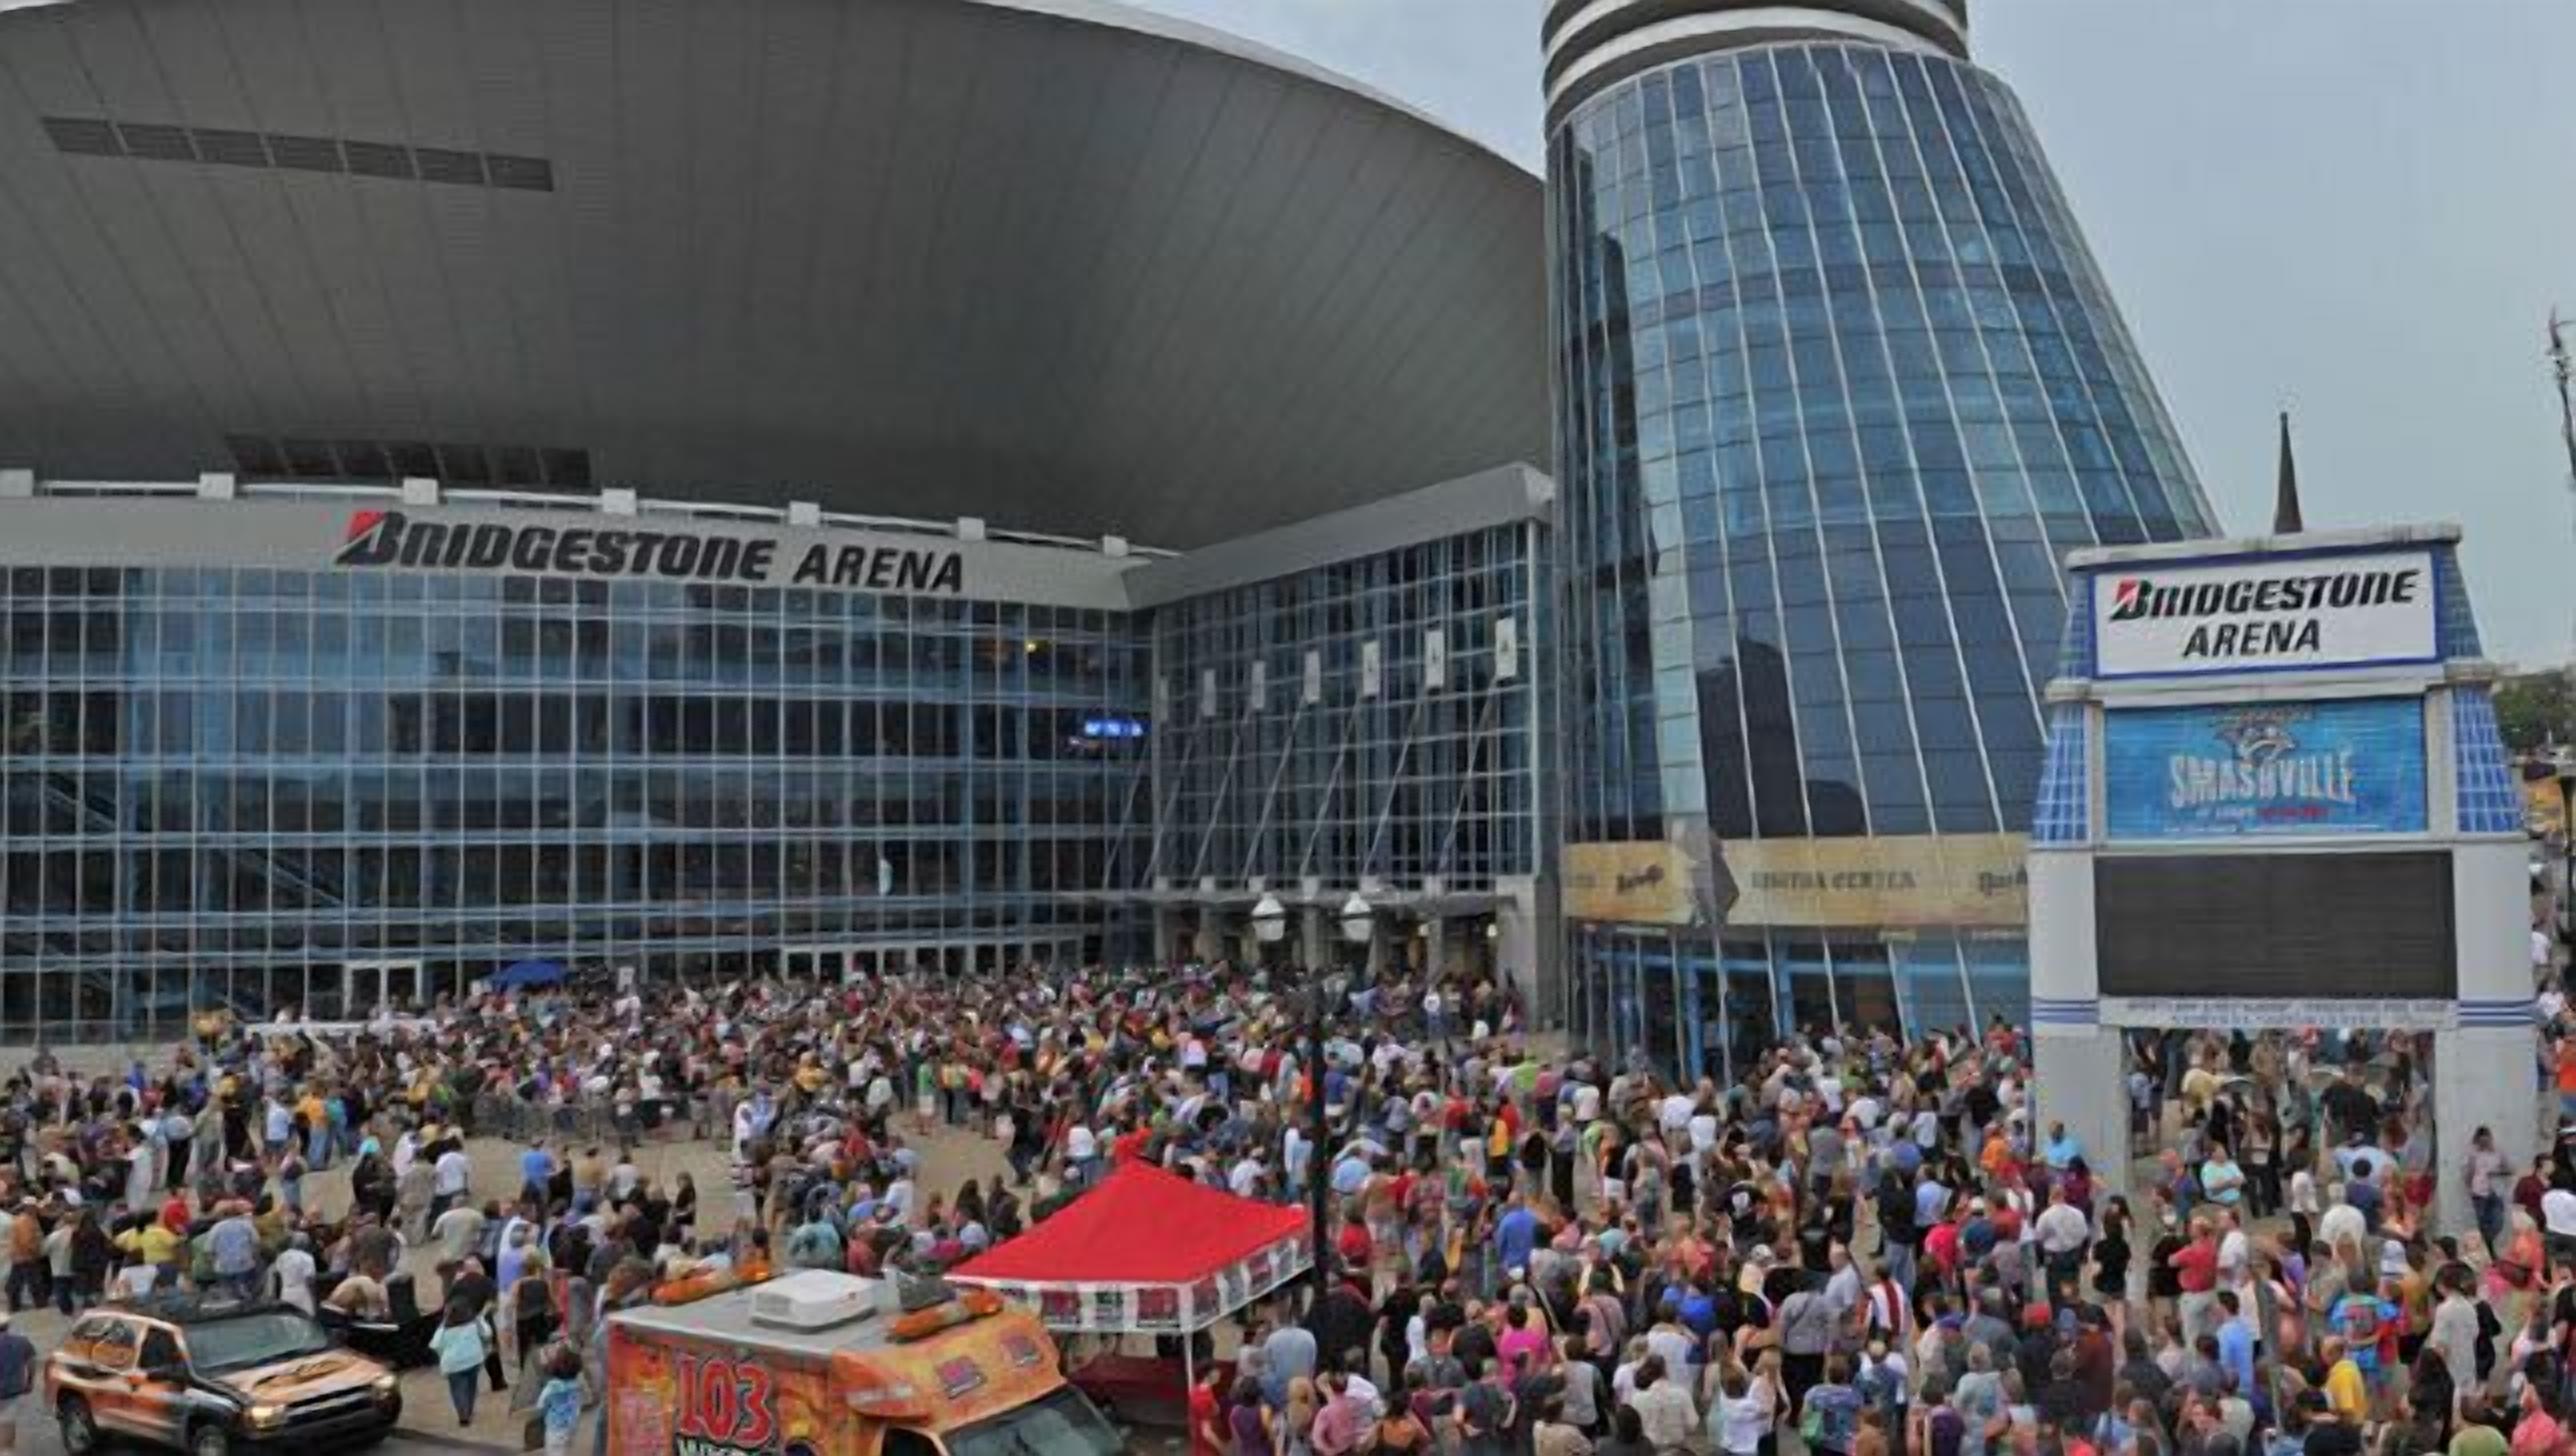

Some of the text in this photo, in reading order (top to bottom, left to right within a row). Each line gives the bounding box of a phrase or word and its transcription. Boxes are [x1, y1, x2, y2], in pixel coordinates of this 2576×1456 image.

[334, 509, 963, 594] BRIDGESTONE ARENA
[2109, 568, 2421, 621] BRIDGESTONE
[2183, 618, 2321, 658] ARENA
[2167, 750, 2357, 809] SMASHVILLE
[679, 1353, 773, 1447] 103
